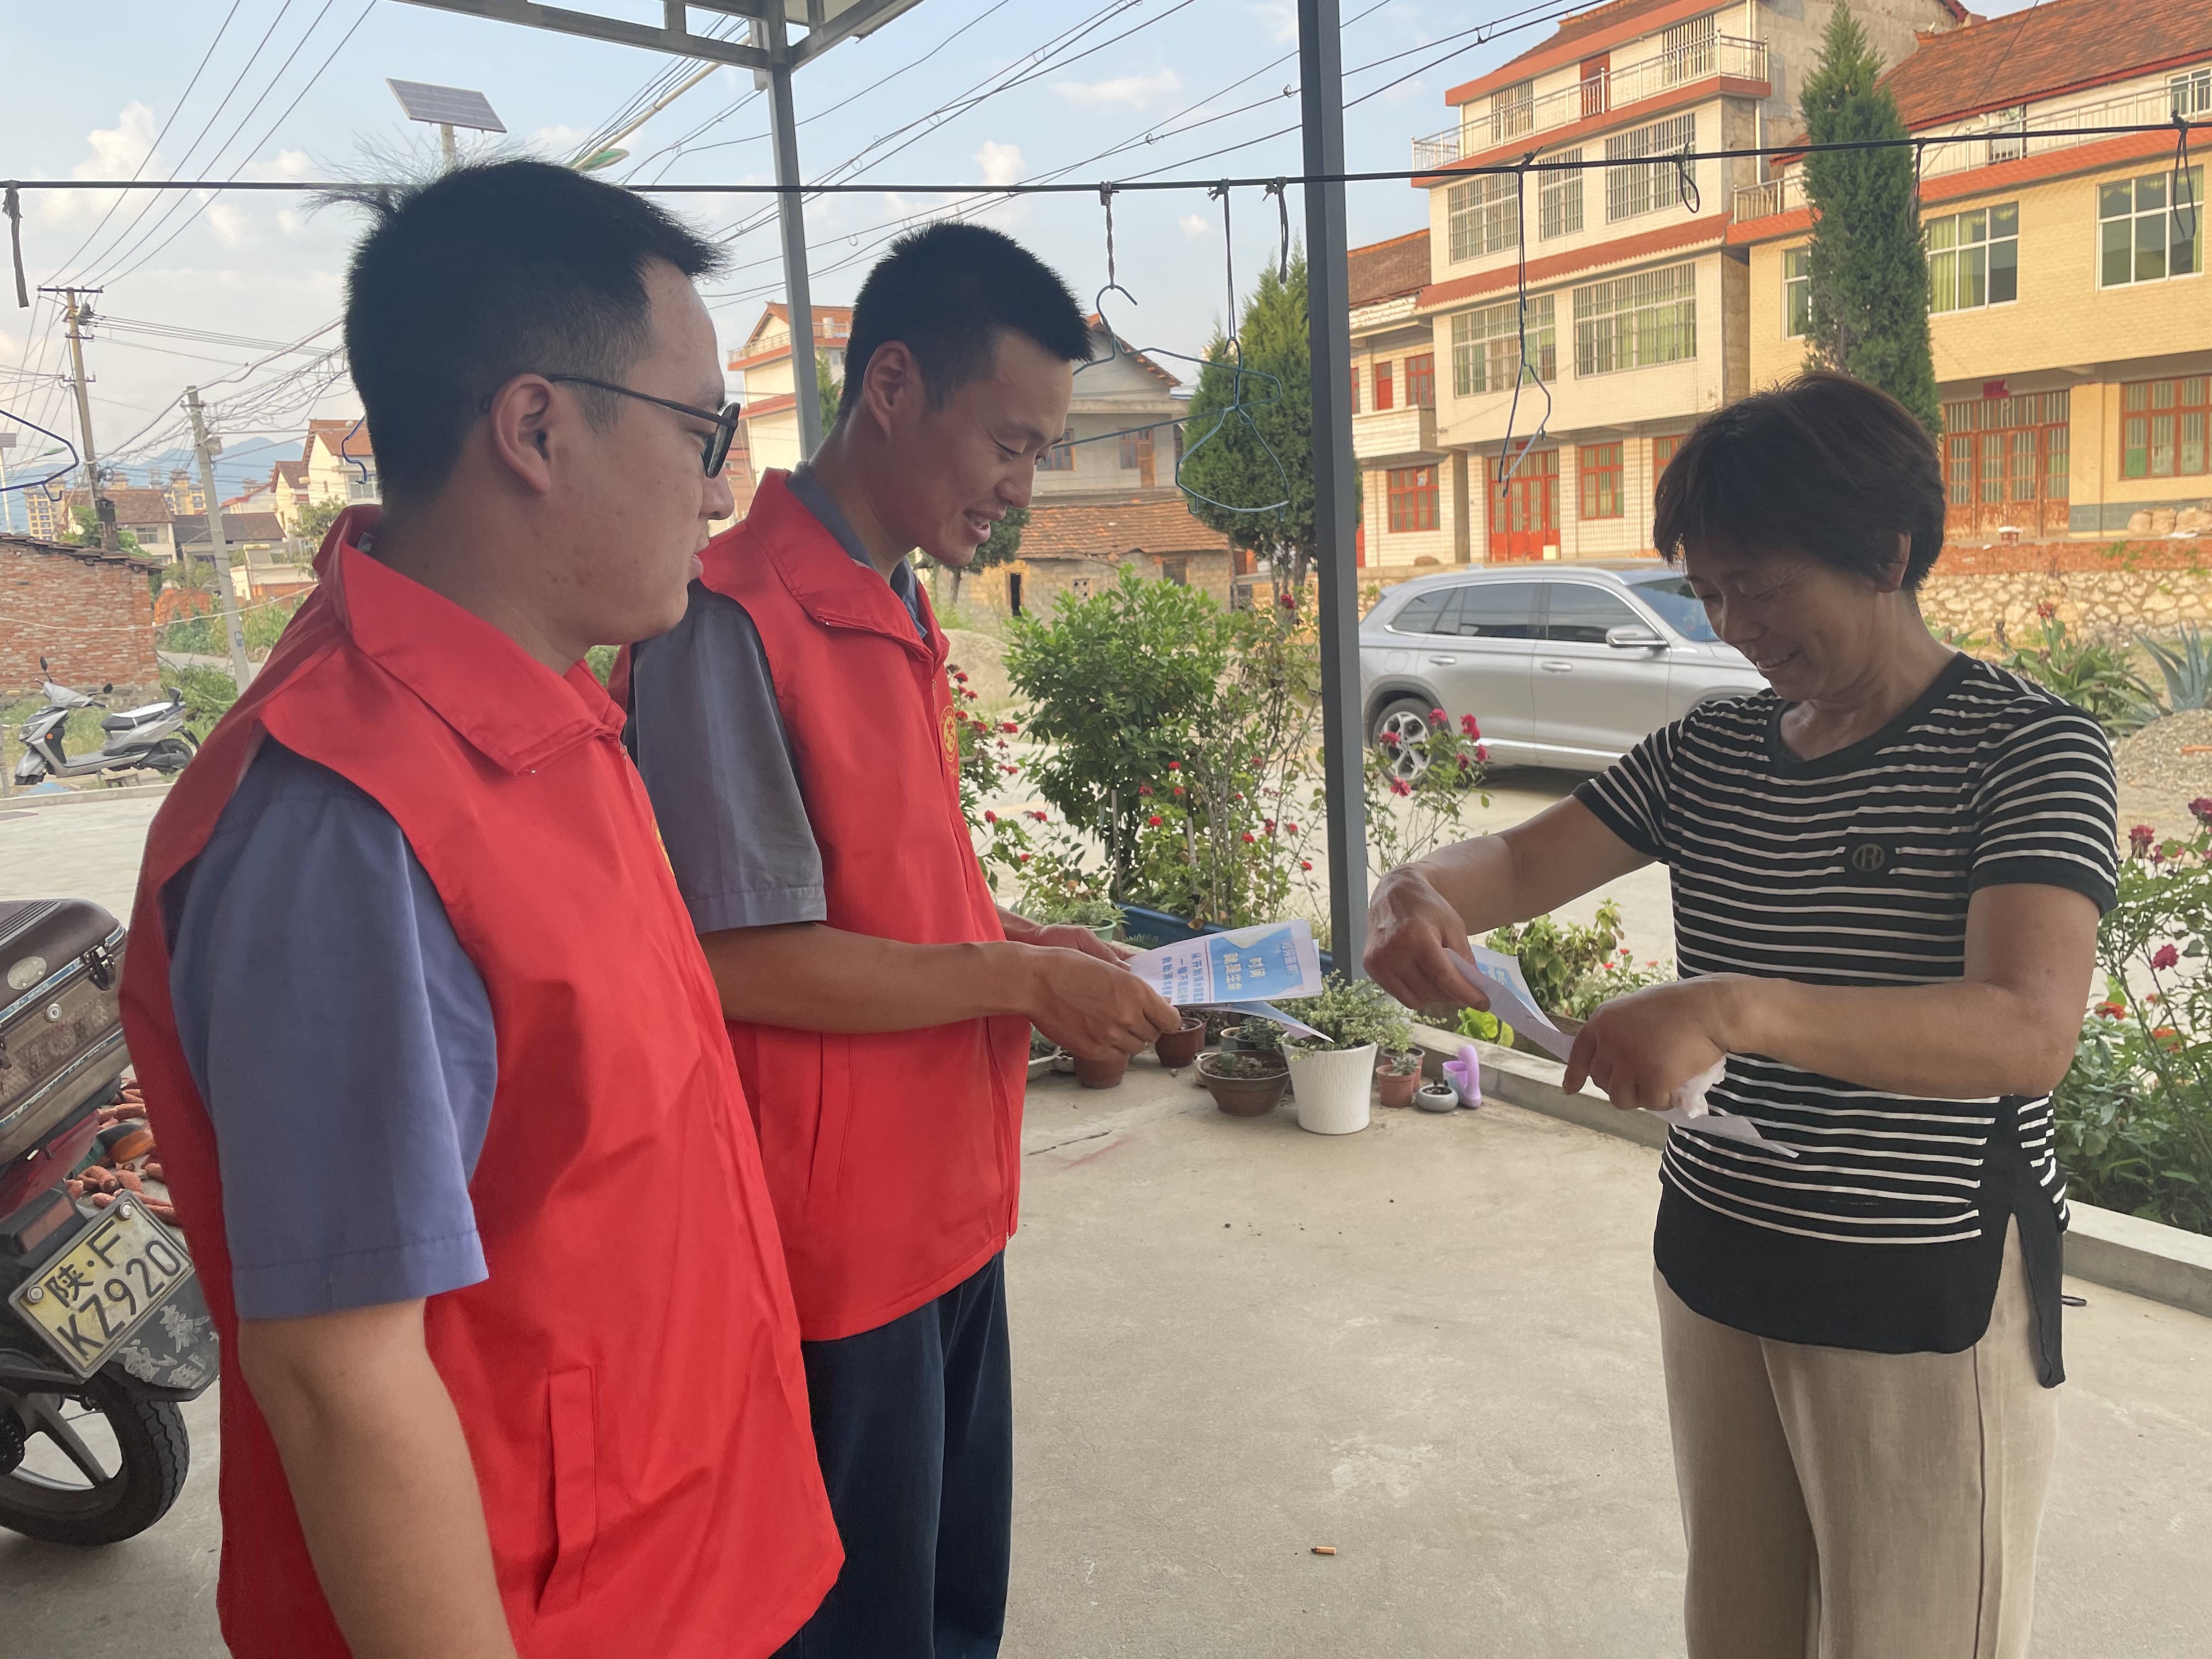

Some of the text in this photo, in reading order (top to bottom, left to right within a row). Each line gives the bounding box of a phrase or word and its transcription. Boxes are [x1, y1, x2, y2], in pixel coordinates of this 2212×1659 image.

[1223, 952, 1243, 990] 就是生命
[1249, 957, 1266, 977] 时间
[57, 1240, 180, 1360] KZ920
